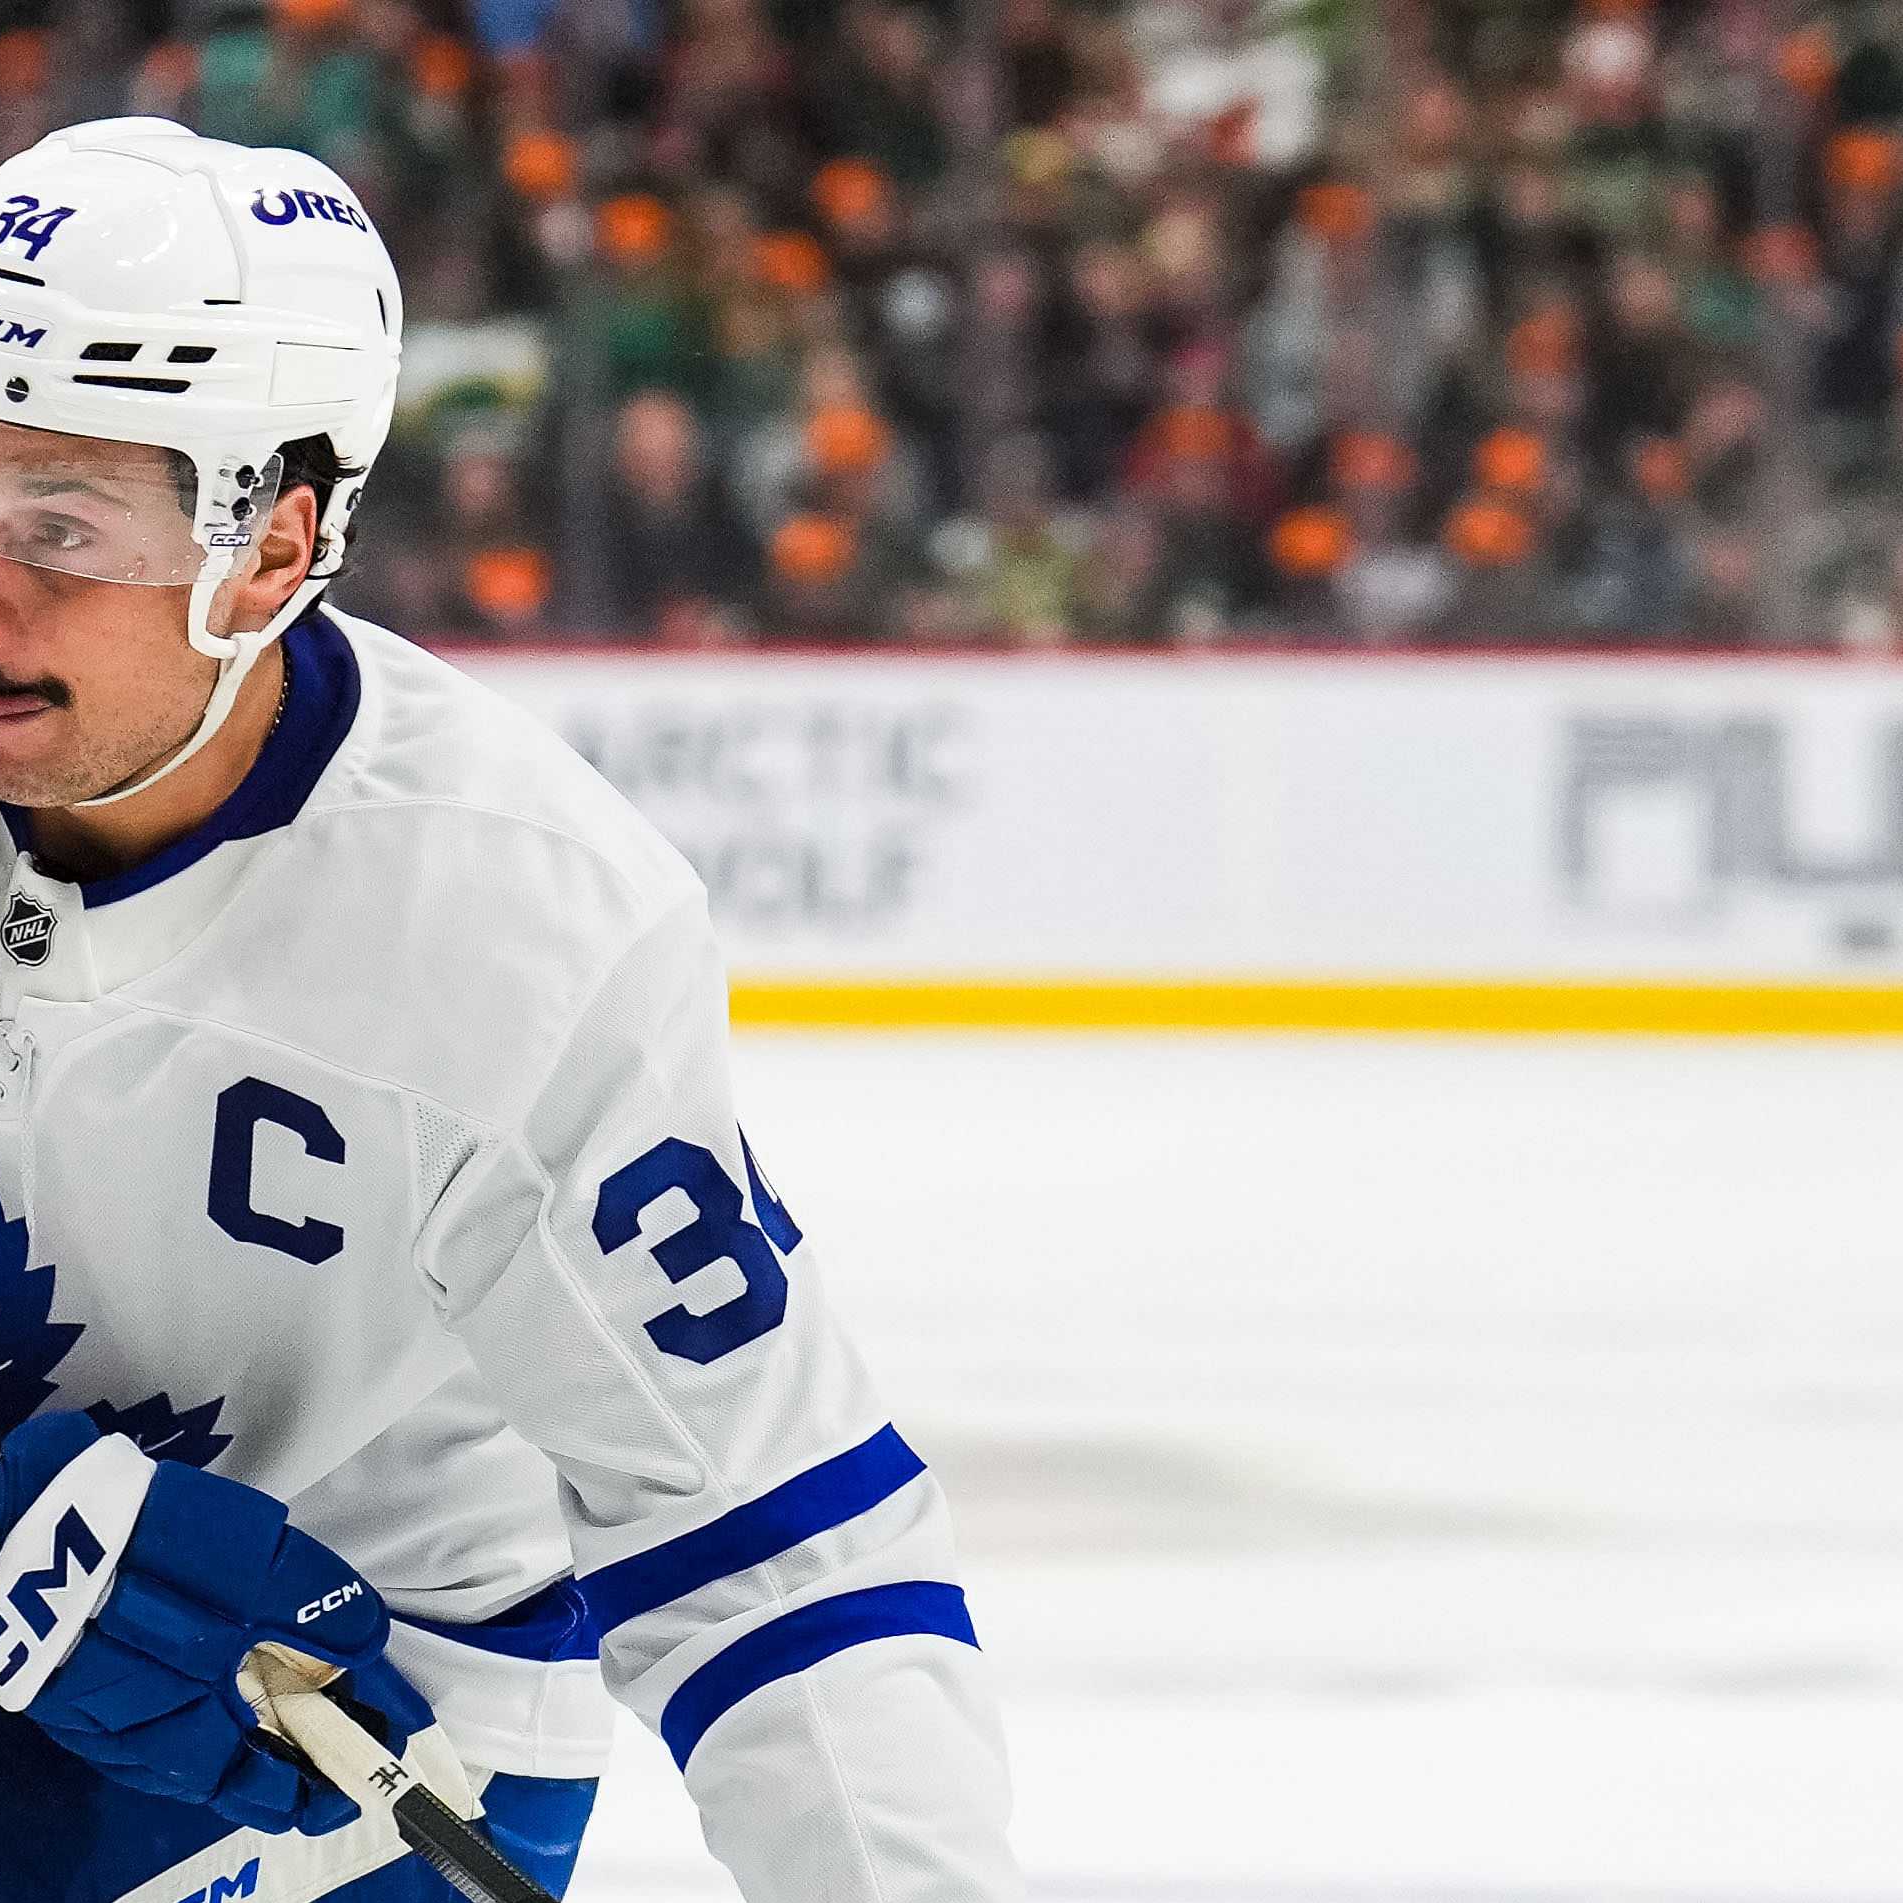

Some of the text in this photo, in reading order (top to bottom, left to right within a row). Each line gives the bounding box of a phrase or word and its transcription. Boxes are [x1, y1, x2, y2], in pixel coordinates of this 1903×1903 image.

[250, 188, 368, 233] OREO
[210, 534, 251, 547] CCM
[7, 919, 50, 946] NHL
[206, 1076, 346, 1266] C
[296, 1580, 364, 1624] CCM
